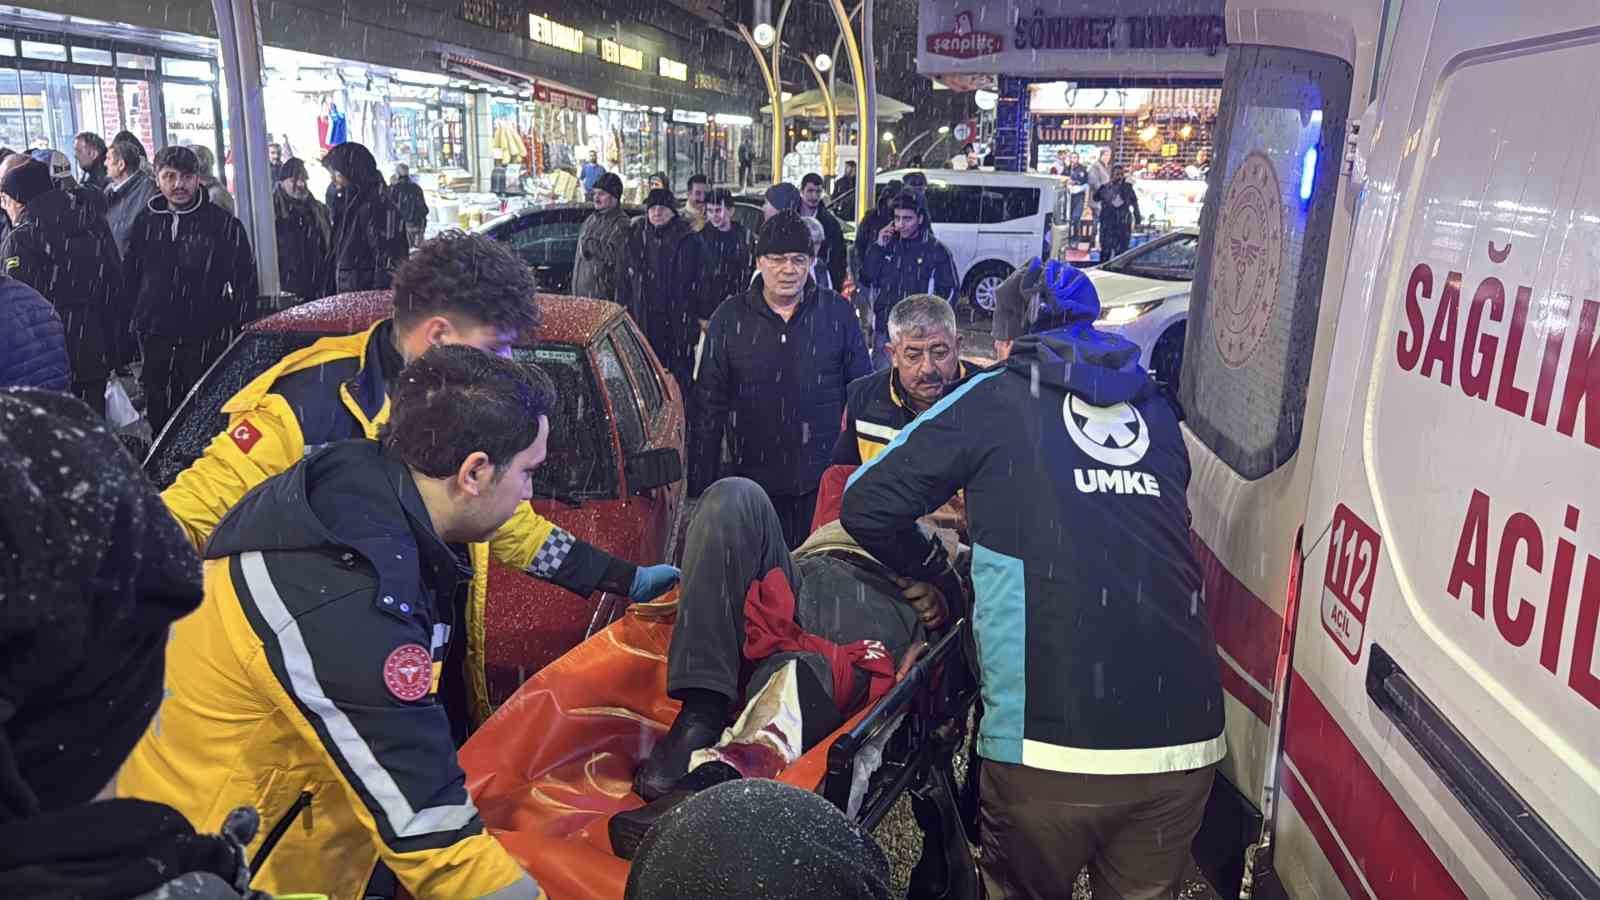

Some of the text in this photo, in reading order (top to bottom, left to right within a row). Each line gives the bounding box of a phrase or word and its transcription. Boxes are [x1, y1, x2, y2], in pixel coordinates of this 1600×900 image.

[1073, 468, 1161, 497] UMKE
[1332, 519, 1372, 613] 112
[1330, 603, 1350, 638] ACİL
[1447, 488, 1600, 710] ACİL
